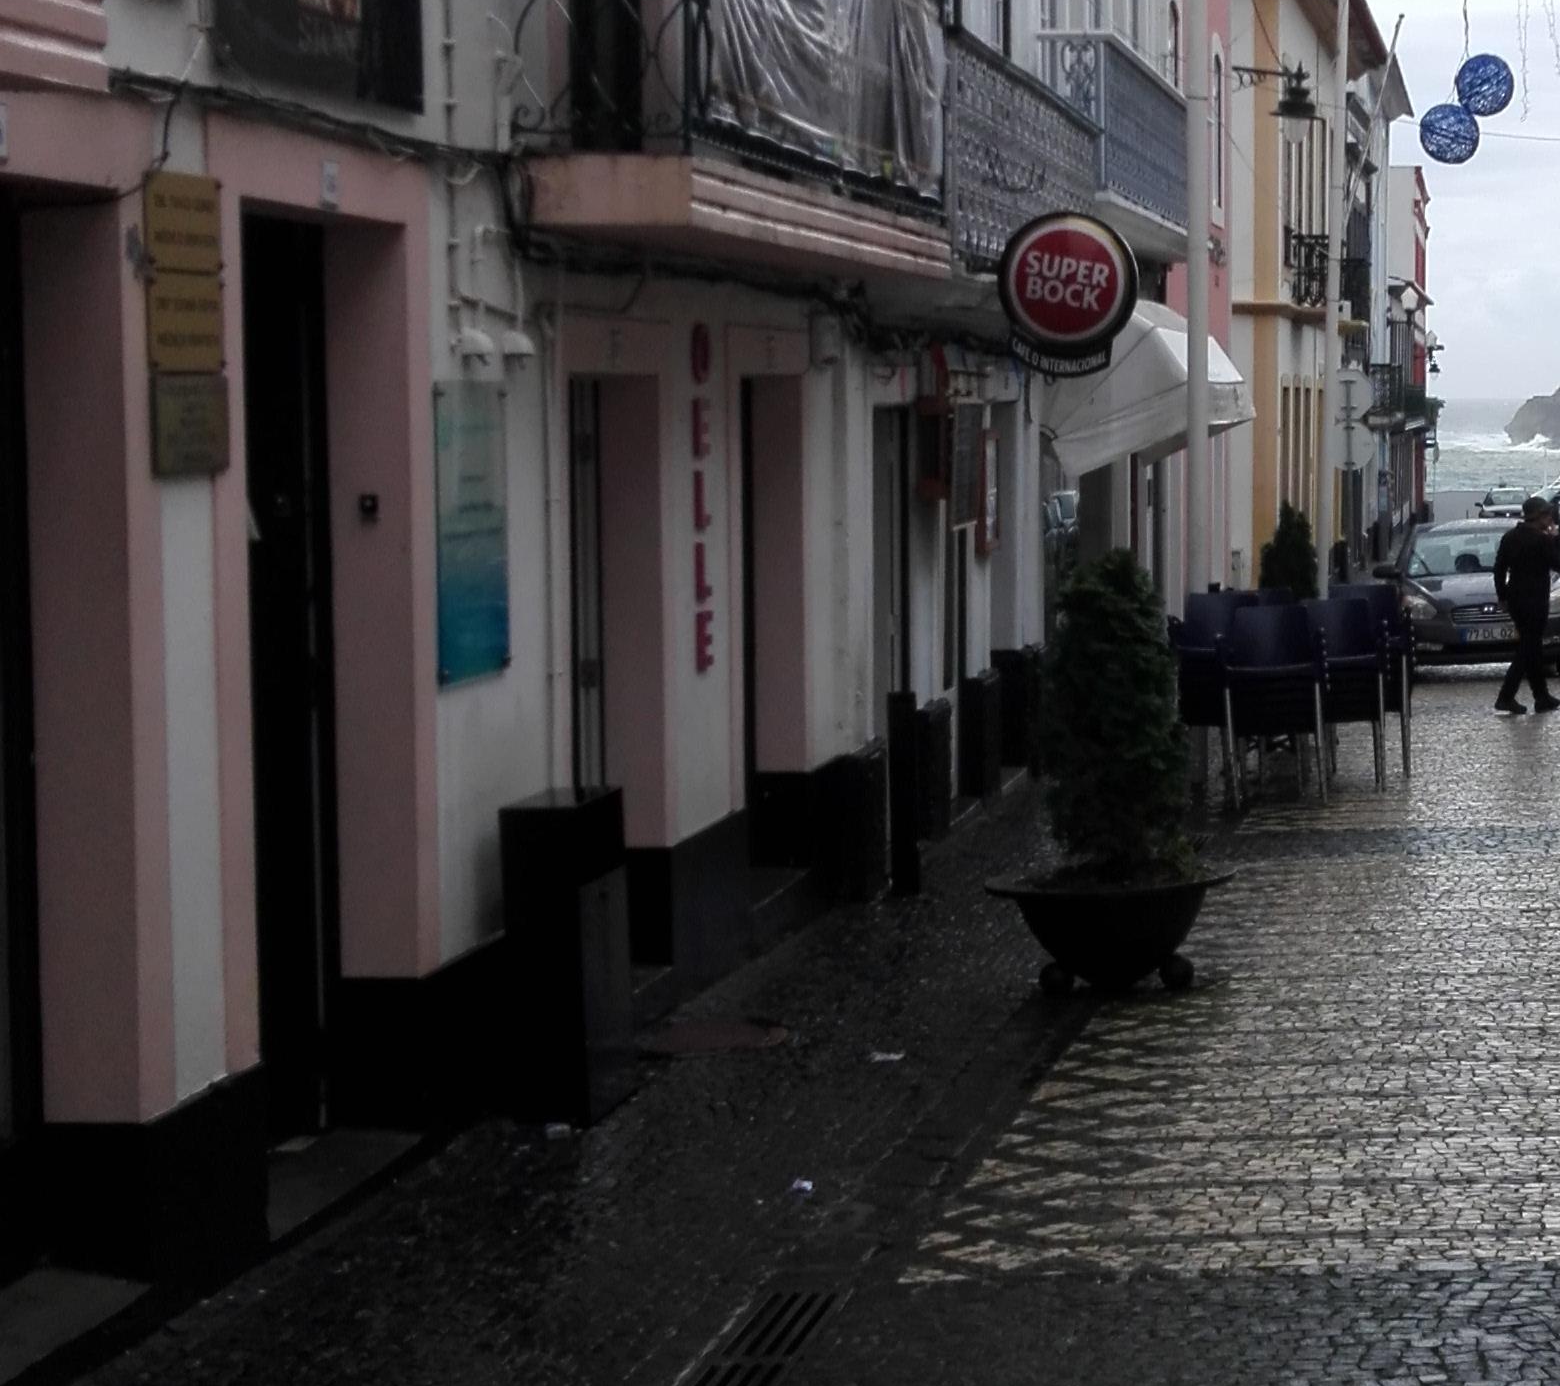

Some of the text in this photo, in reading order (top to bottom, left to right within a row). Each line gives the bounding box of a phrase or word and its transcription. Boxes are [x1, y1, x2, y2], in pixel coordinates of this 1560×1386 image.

[1025, 251, 1111, 288] SUPER
[1025, 276, 1101, 311] BOCK
[1040, 351, 1106, 373] INTERNACIONAL
